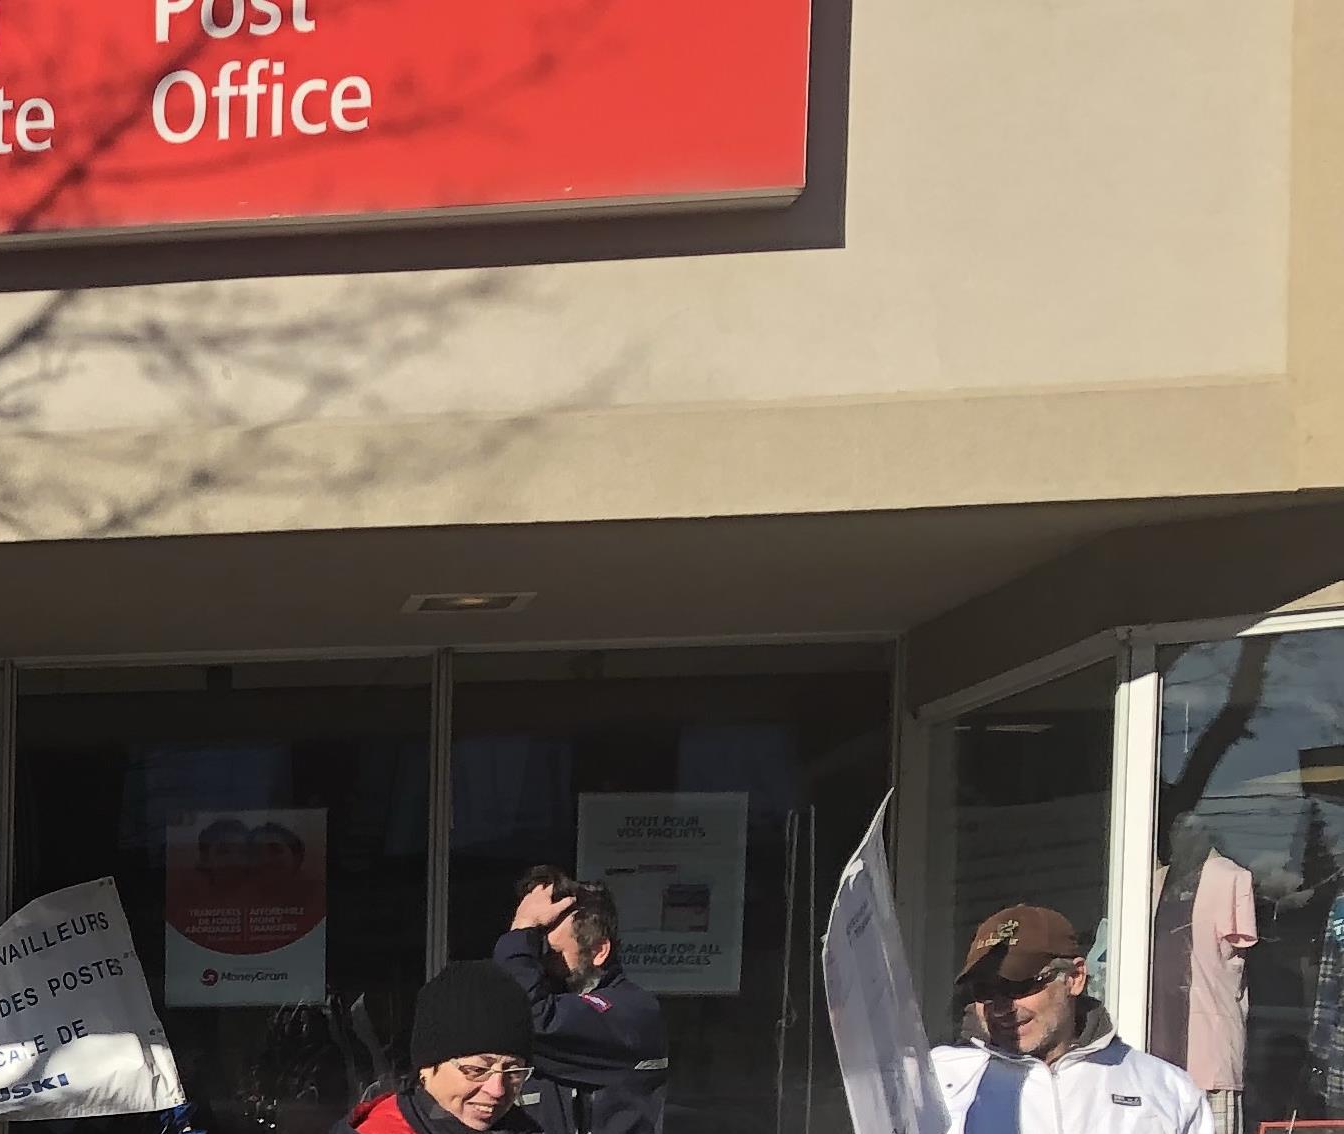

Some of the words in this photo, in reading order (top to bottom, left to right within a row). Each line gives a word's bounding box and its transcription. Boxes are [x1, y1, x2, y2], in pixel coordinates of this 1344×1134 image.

[155, 0, 316, 43] Post
[151, 58, 372, 143] Office
[624, 943, 667, 955] AGING
[221, 970, 289, 983] MoneyGram
[56, 1019, 89, 1045] DE
